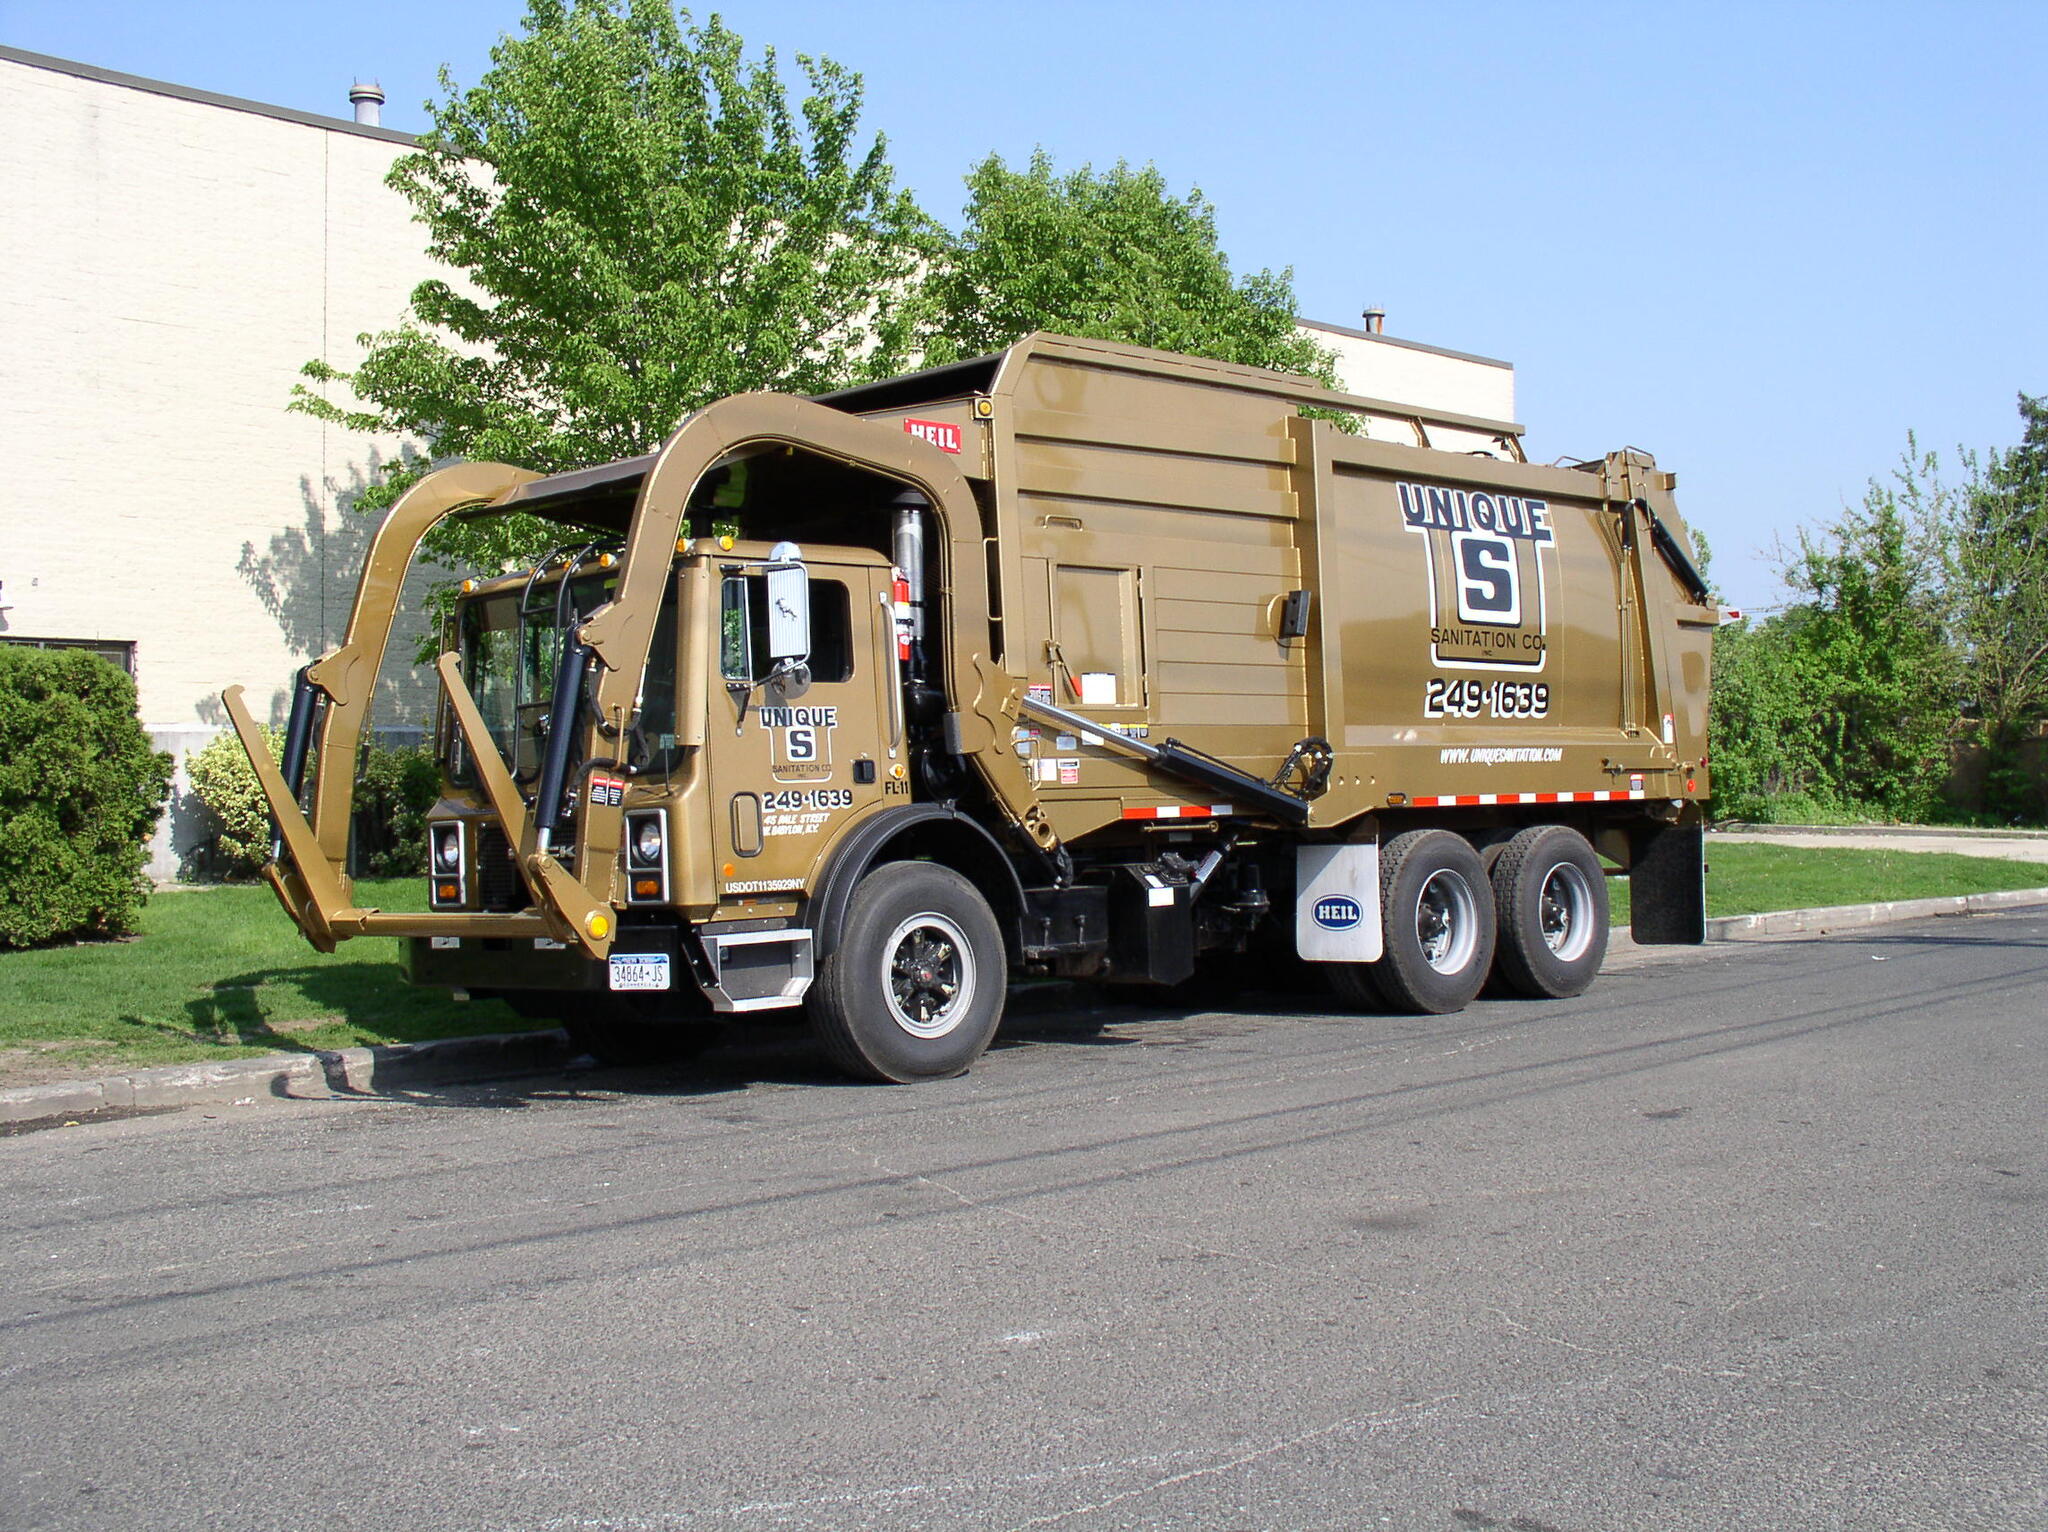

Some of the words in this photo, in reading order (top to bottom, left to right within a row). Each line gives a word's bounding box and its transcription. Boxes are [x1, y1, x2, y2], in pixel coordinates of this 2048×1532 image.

[911, 424, 957, 449] HEIL
[1397, 482, 1554, 543] UNIQUE
[1460, 537, 1513, 613] S
[1431, 628, 1516, 649] SANITATION
[760, 706, 837, 727] UNIQUE
[789, 730, 813, 758] S
[772, 764, 820, 774] SANITATION
[800, 812, 830, 824] STREET
[1318, 905, 1358, 920] HEIL
